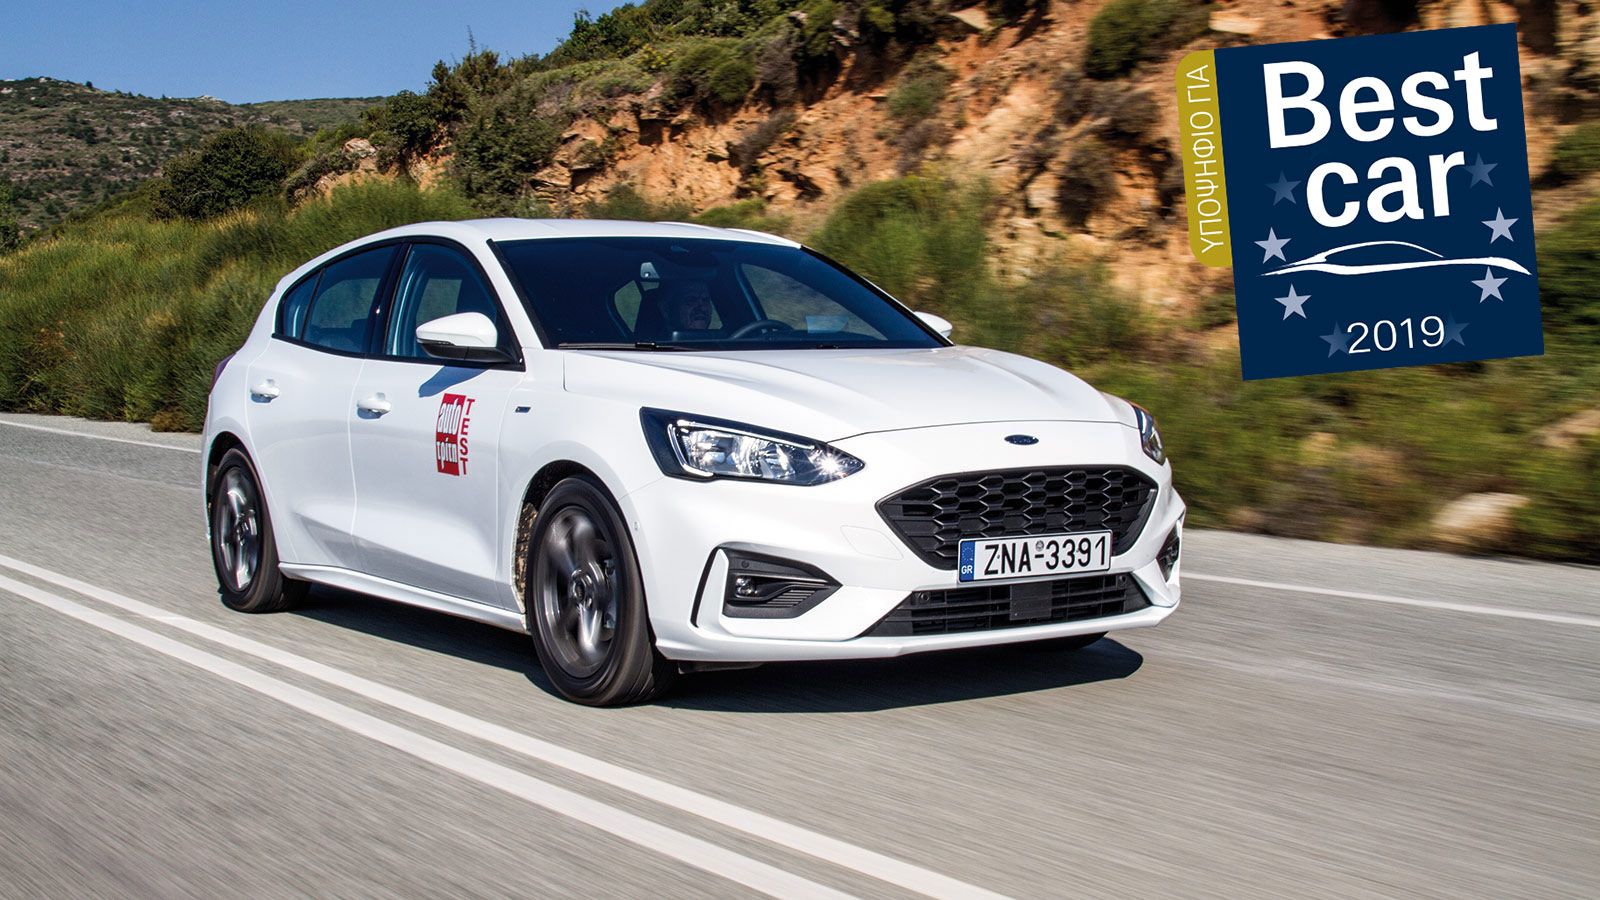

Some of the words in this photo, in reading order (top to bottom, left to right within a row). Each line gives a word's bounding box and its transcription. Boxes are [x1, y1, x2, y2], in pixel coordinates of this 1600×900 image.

[459, 399, 475, 475] TEST
[961, 565, 973, 575] GR
[984, 537, 1106, 576] ZNA-3391
